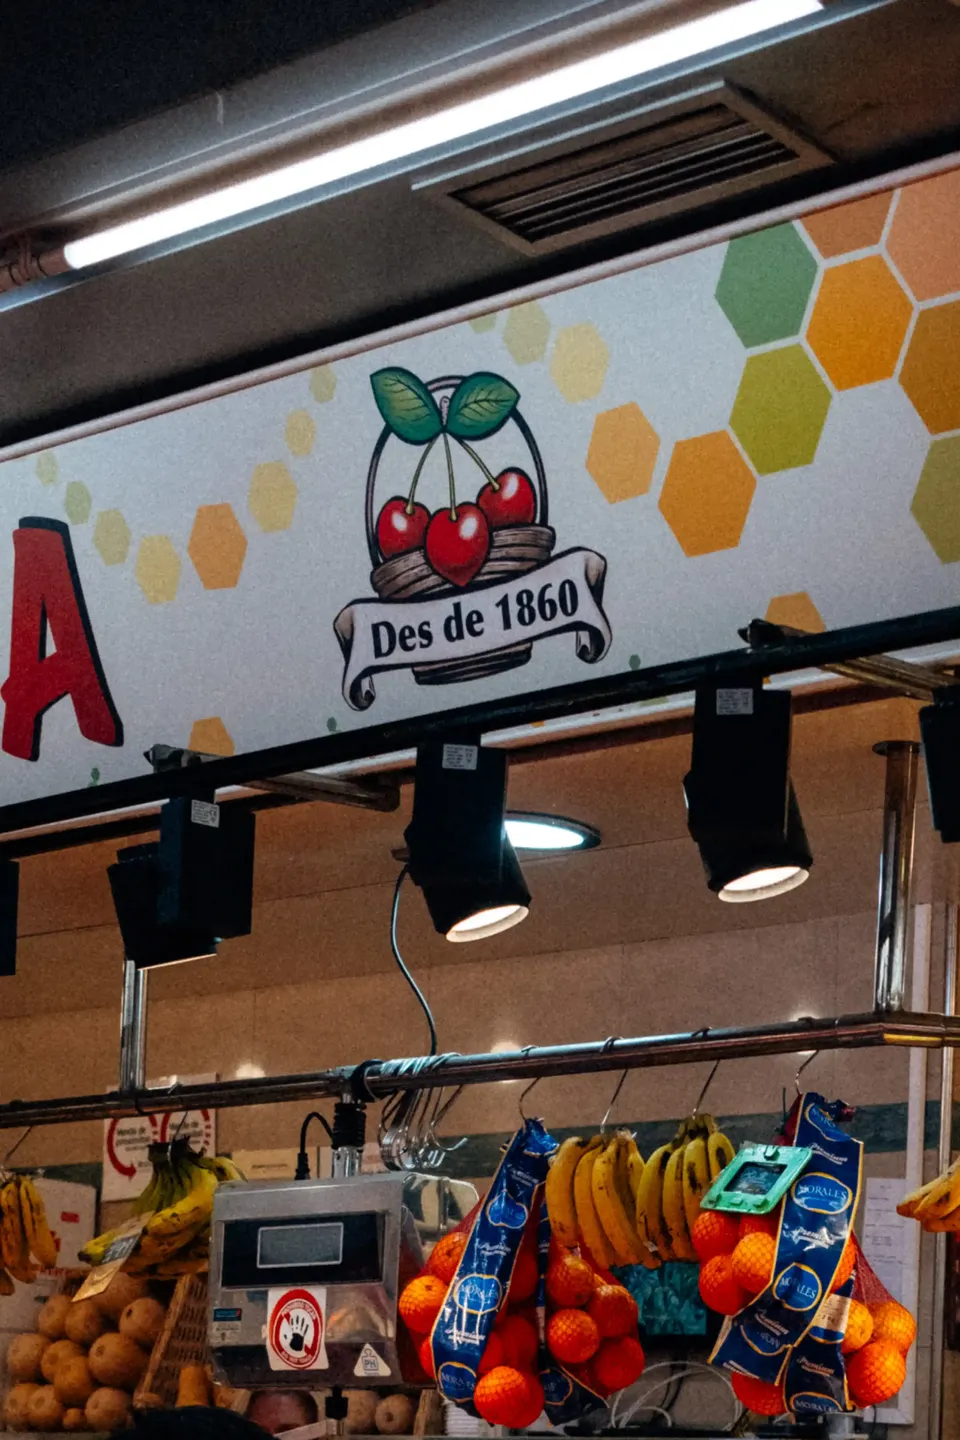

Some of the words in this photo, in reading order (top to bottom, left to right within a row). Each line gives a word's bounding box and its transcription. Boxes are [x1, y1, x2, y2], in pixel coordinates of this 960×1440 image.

[0, 517, 124, 761] A
[371, 617, 433, 660] Des
[443, 601, 486, 640] de
[495, 577, 579, 632] 1860
